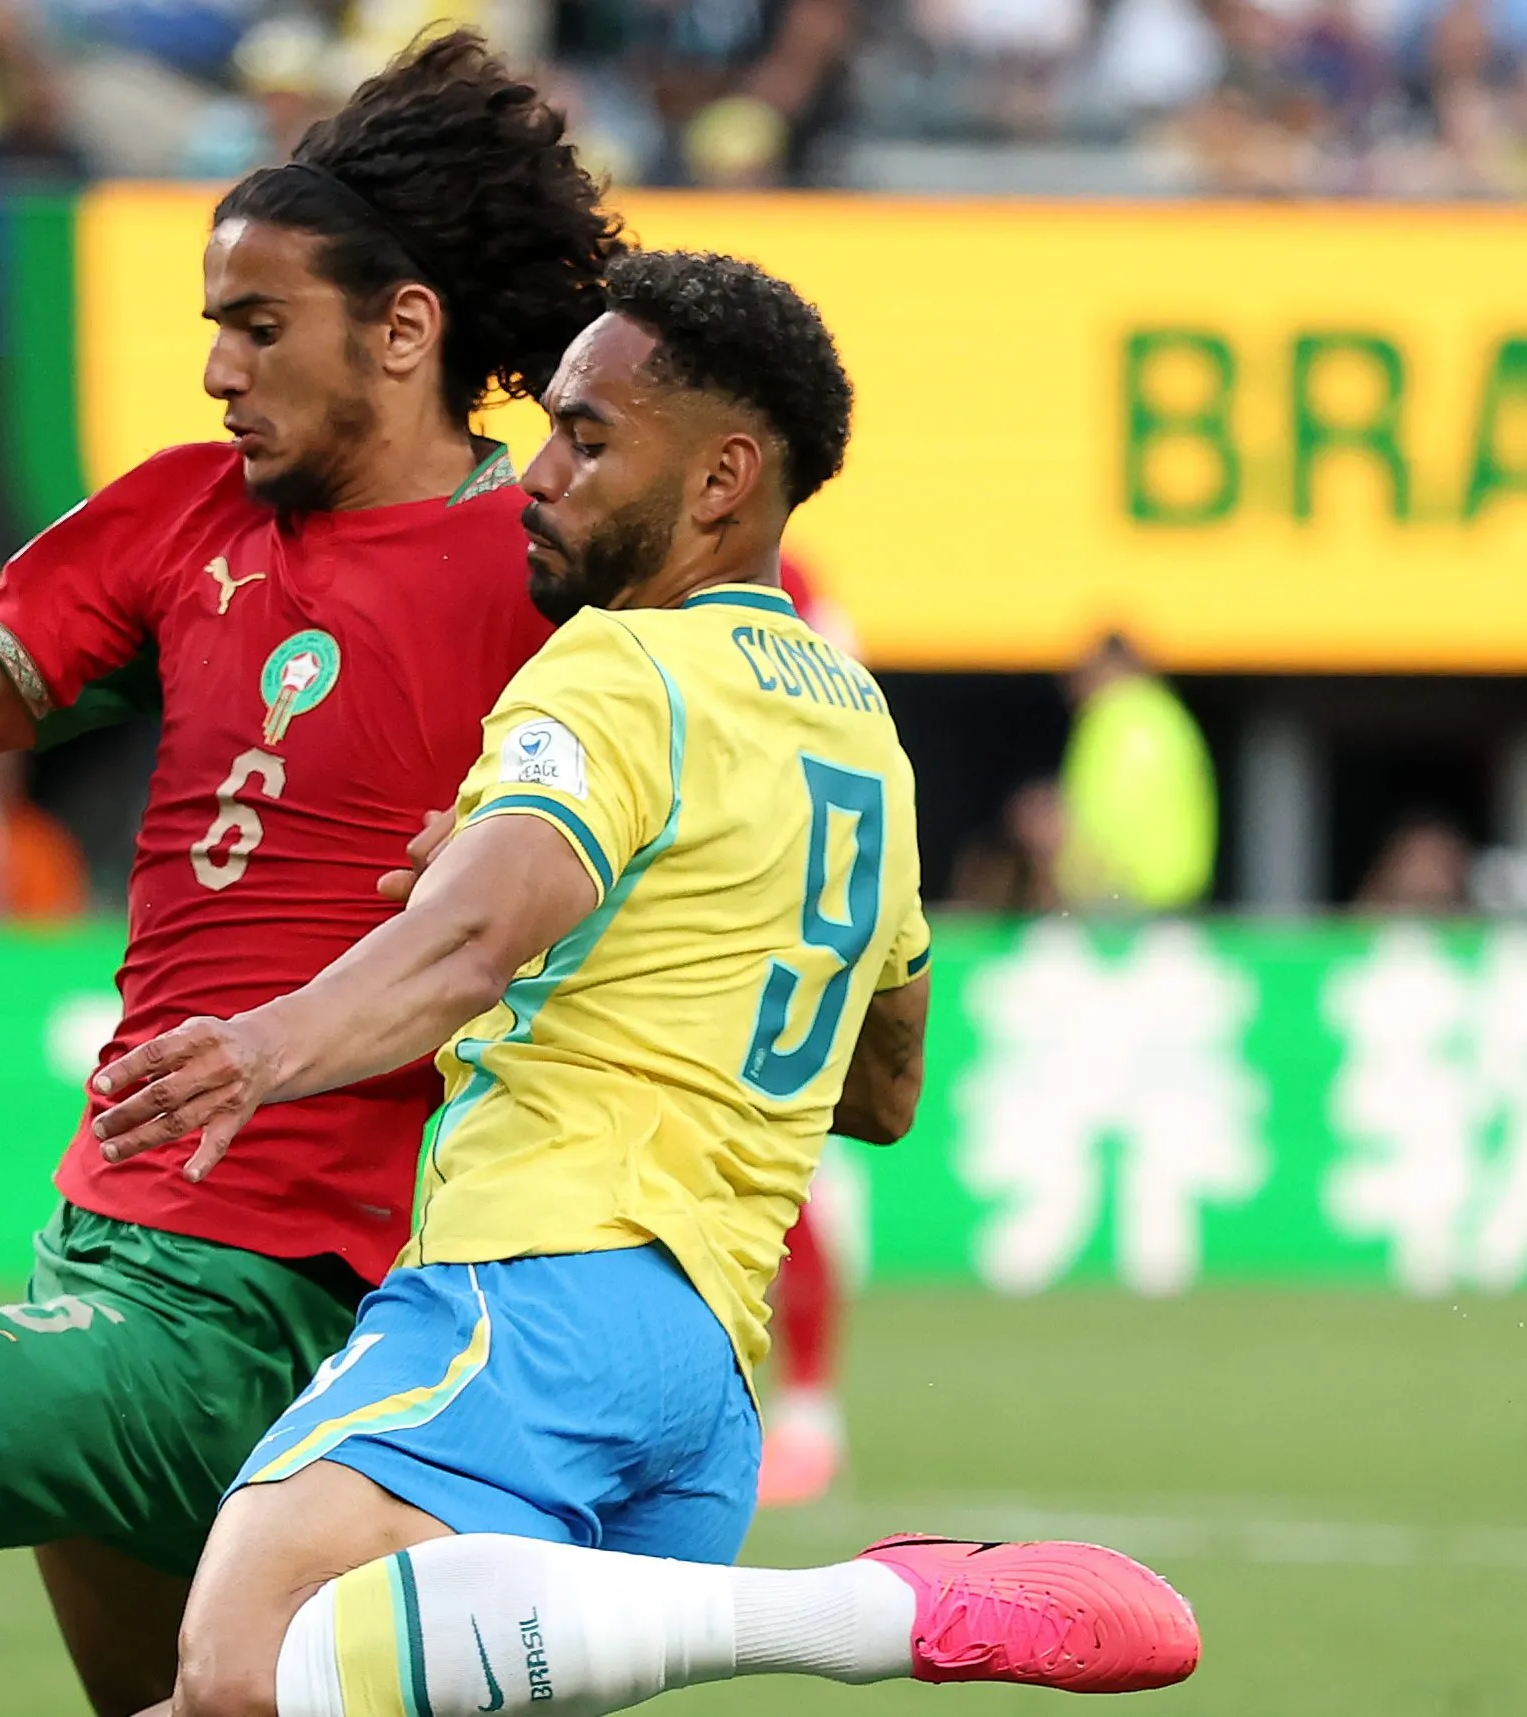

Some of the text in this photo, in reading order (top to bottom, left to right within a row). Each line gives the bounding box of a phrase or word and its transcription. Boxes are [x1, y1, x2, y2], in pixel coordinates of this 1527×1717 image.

[731, 626, 885, 715] CUNHA
[190, 747, 287, 891] 6
[739, 750, 885, 1101] 9
[519, 1606, 553, 1702] BRASIL
